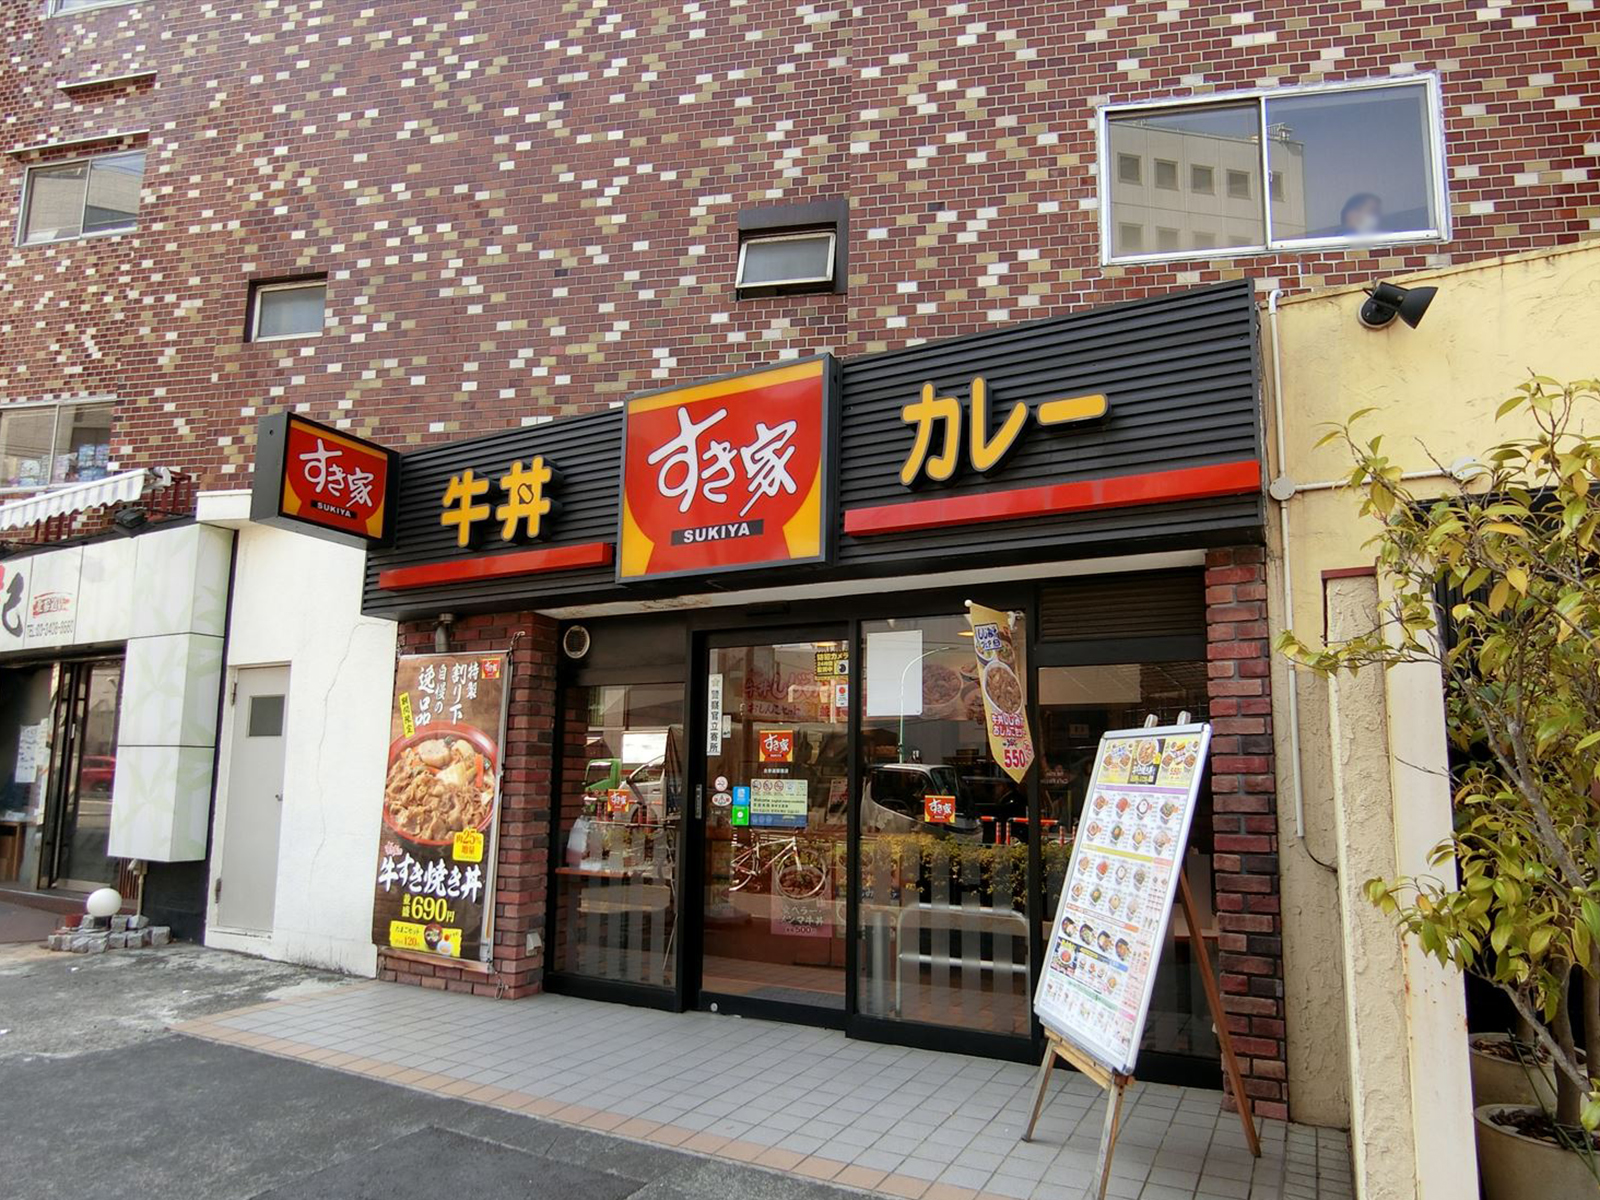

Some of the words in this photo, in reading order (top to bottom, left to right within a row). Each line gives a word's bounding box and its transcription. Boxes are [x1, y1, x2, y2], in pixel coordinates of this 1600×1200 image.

[900, 376, 1109, 485] カレー
[299, 438, 374, 508] すき家
[647, 406, 799, 517] すき家
[317, 502, 352, 518] SUKIYA
[440, 455, 554, 549] 牛丼
[683, 522, 751, 544] SUKIYA
[414, 664, 436, 727] 逸品
[449, 662, 468, 726] 割り下
[764, 733, 790, 753] すき家
[1003, 749, 1026, 768] 550
[928, 798, 952, 816] すき家
[378, 852, 483, 903] 牛すき焼き丼
